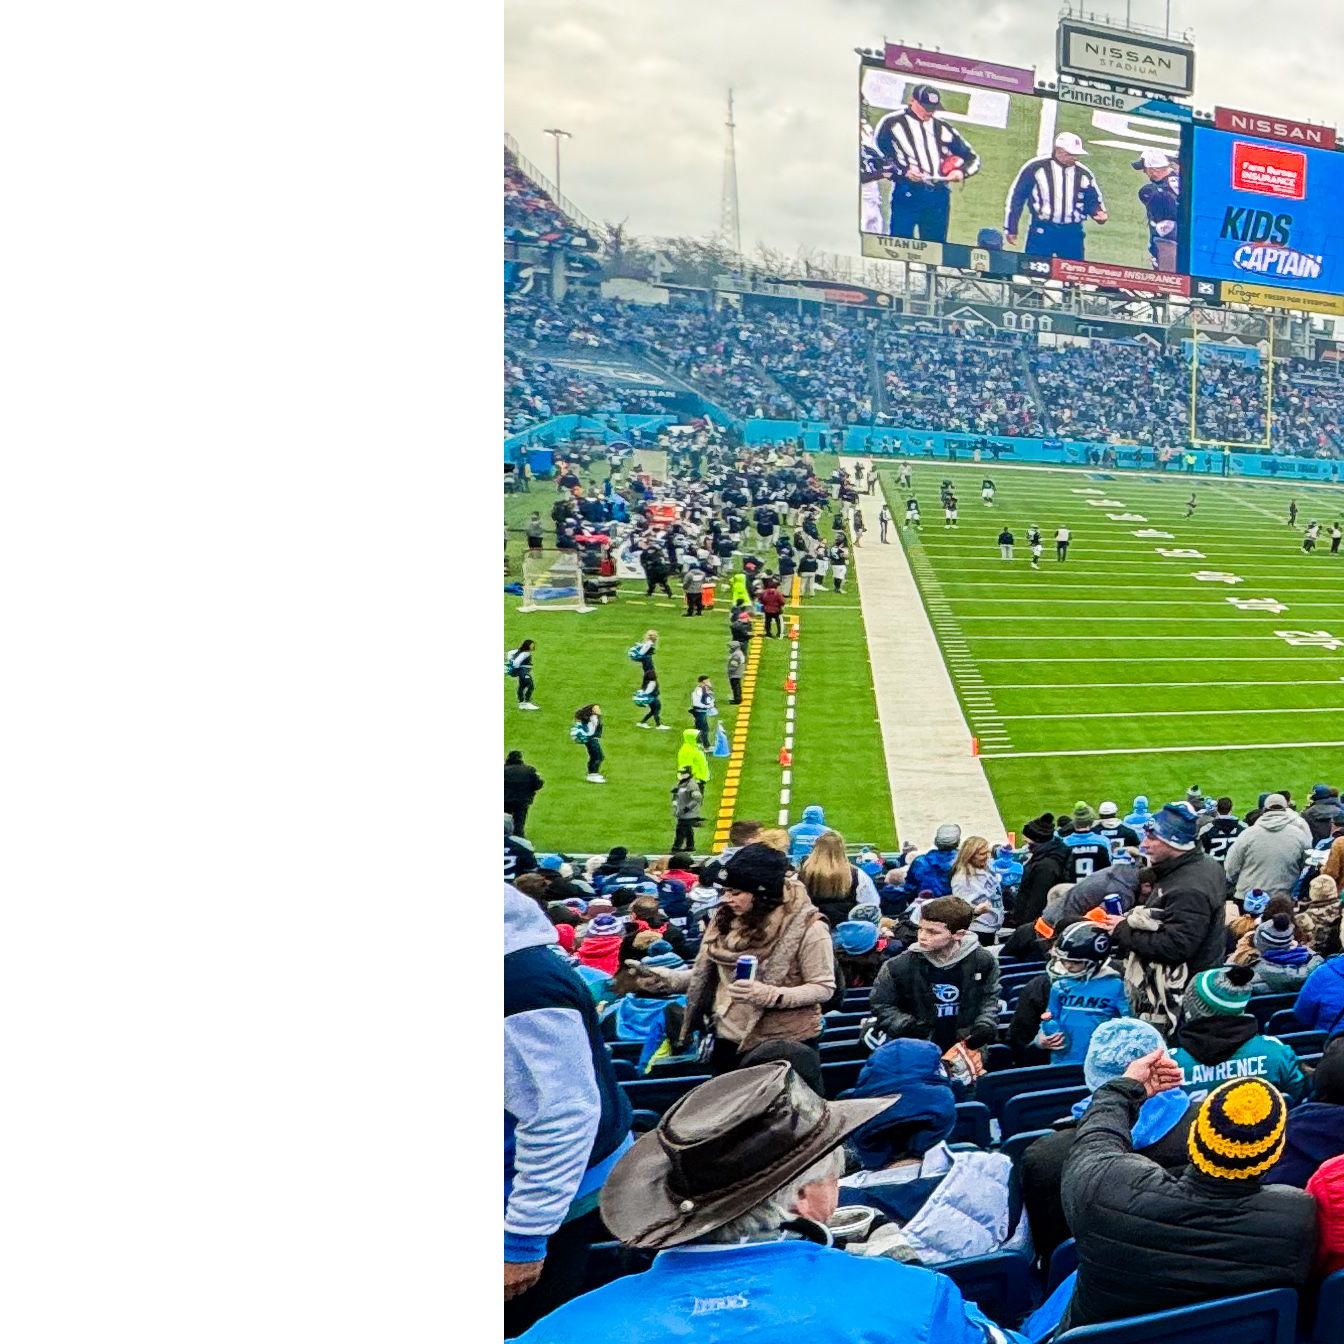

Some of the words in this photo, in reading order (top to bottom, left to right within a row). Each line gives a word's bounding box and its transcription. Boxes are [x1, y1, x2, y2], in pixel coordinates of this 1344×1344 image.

[1085, 42, 1172, 69] NISSAN
[1099, 58, 1159, 76] STADIUM
[1060, 84, 1126, 109] Pinnacle
[1231, 114, 1321, 143] NISSAN
[1220, 206, 1293, 246] KIDS
[877, 236, 909, 249] TITAN
[911, 242, 928, 251] UP
[1060, 262, 1086, 273] Farm
[1088, 265, 1122, 278] Bureau
[1124, 269, 1183, 286] INSURANCE
[1234, 245, 1323, 278] CAPTAIN
[1228, 284, 1261, 302] Kroger
